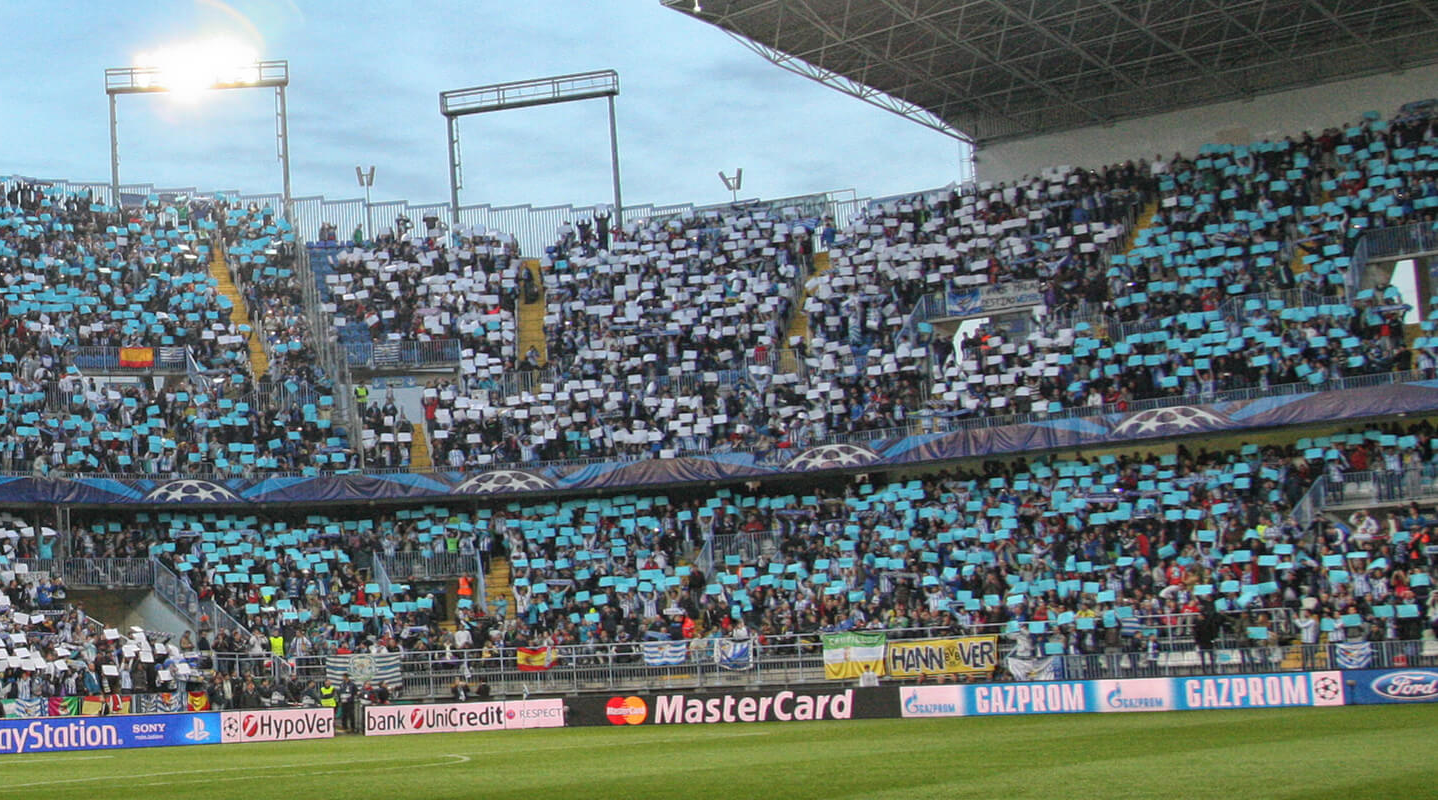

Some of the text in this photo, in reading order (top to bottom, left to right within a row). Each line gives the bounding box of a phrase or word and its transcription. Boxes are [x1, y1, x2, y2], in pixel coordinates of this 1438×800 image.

[975, 683, 1085, 713] GAZPROM
[1185, 675, 1308, 708] GAZPROM
[1387, 675, 1438, 696] Ford
[366, 706, 504, 732] bank UniCredit
[519, 707, 563, 719] RESPECT
[654, 689, 853, 724] MasterCard
[132, 722, 166, 734] SONY
[262, 711, 333, 738] HypoVer
